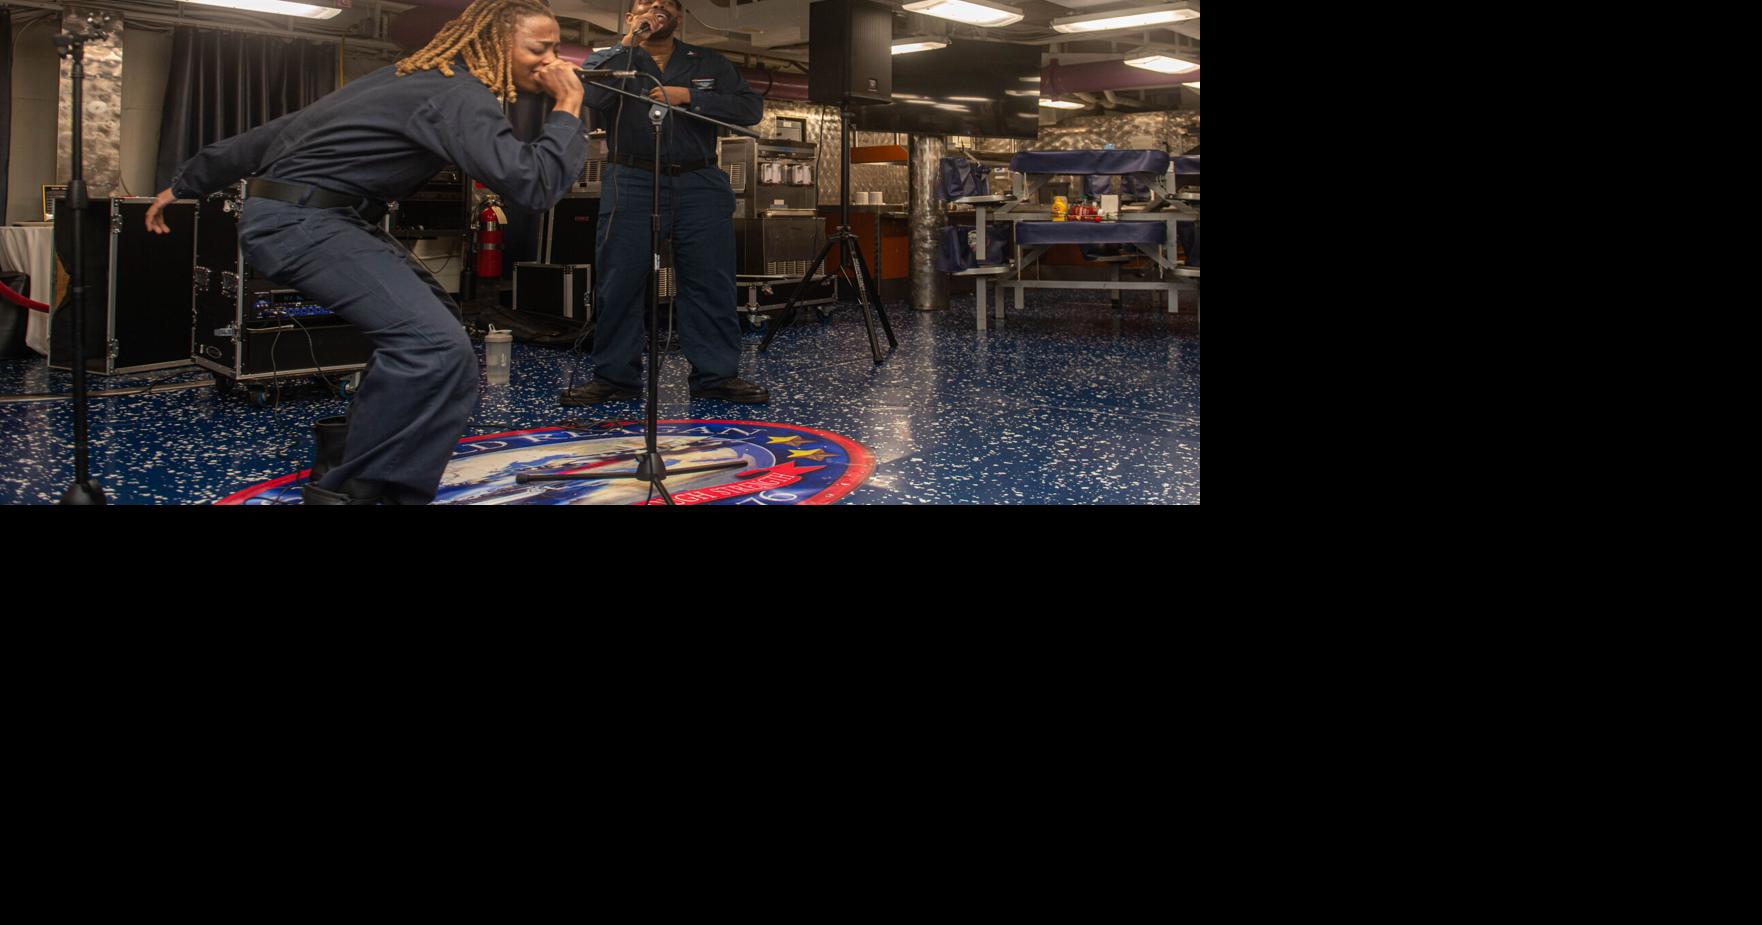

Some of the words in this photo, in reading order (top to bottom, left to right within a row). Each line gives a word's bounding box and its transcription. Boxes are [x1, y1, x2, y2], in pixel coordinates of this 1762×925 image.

[521, 426, 768, 442] REAGAN
[709, 471, 796, 496] STRENGTH
[735, 490, 798, 505] 76
